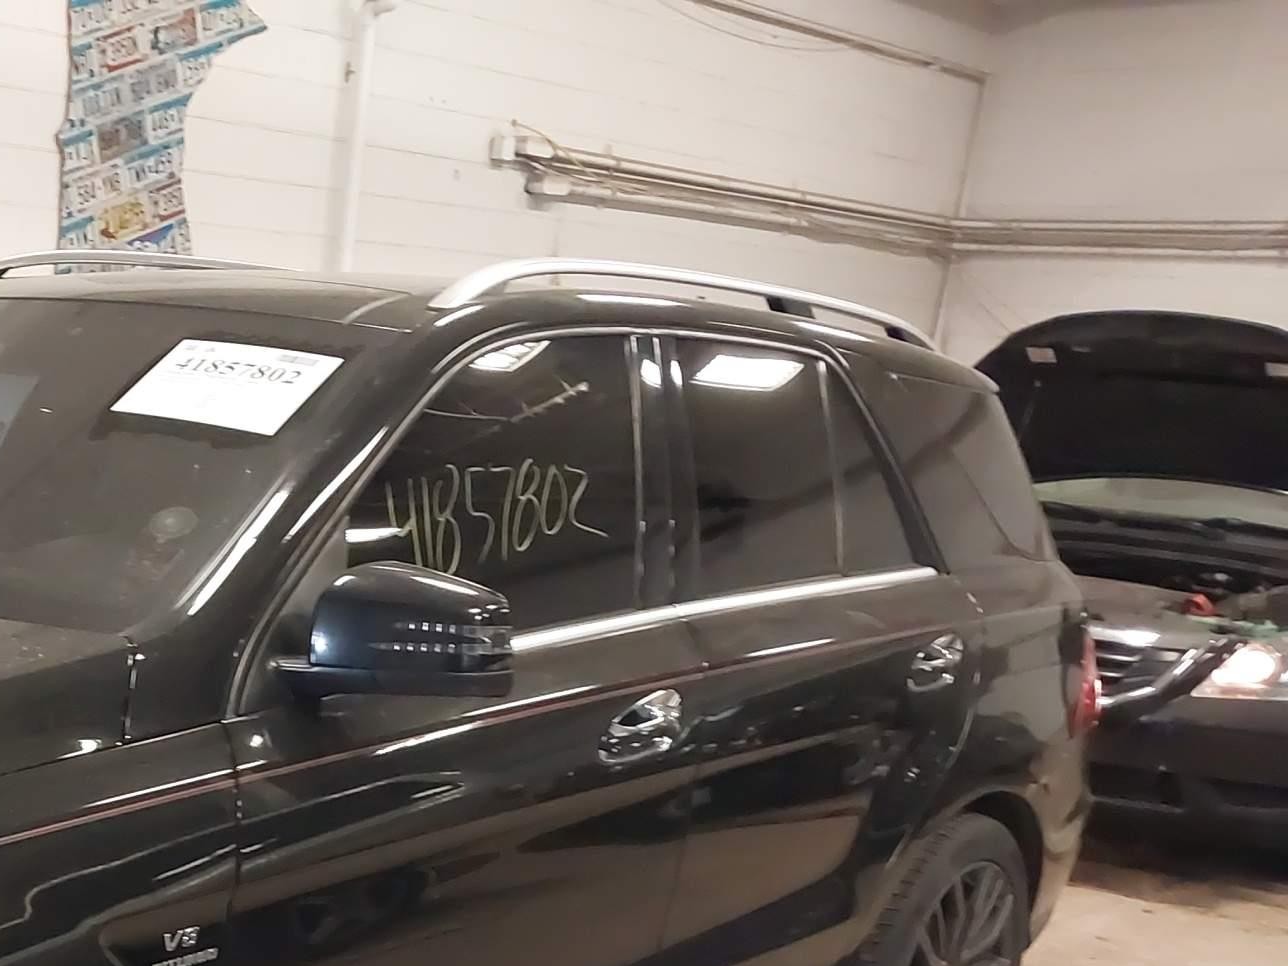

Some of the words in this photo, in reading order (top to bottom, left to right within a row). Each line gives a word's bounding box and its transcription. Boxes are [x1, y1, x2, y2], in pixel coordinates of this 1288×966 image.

[175, 356, 302, 385] 41857802
[384, 457, 609, 576] 41857802
[163, 925, 200, 951] V8
